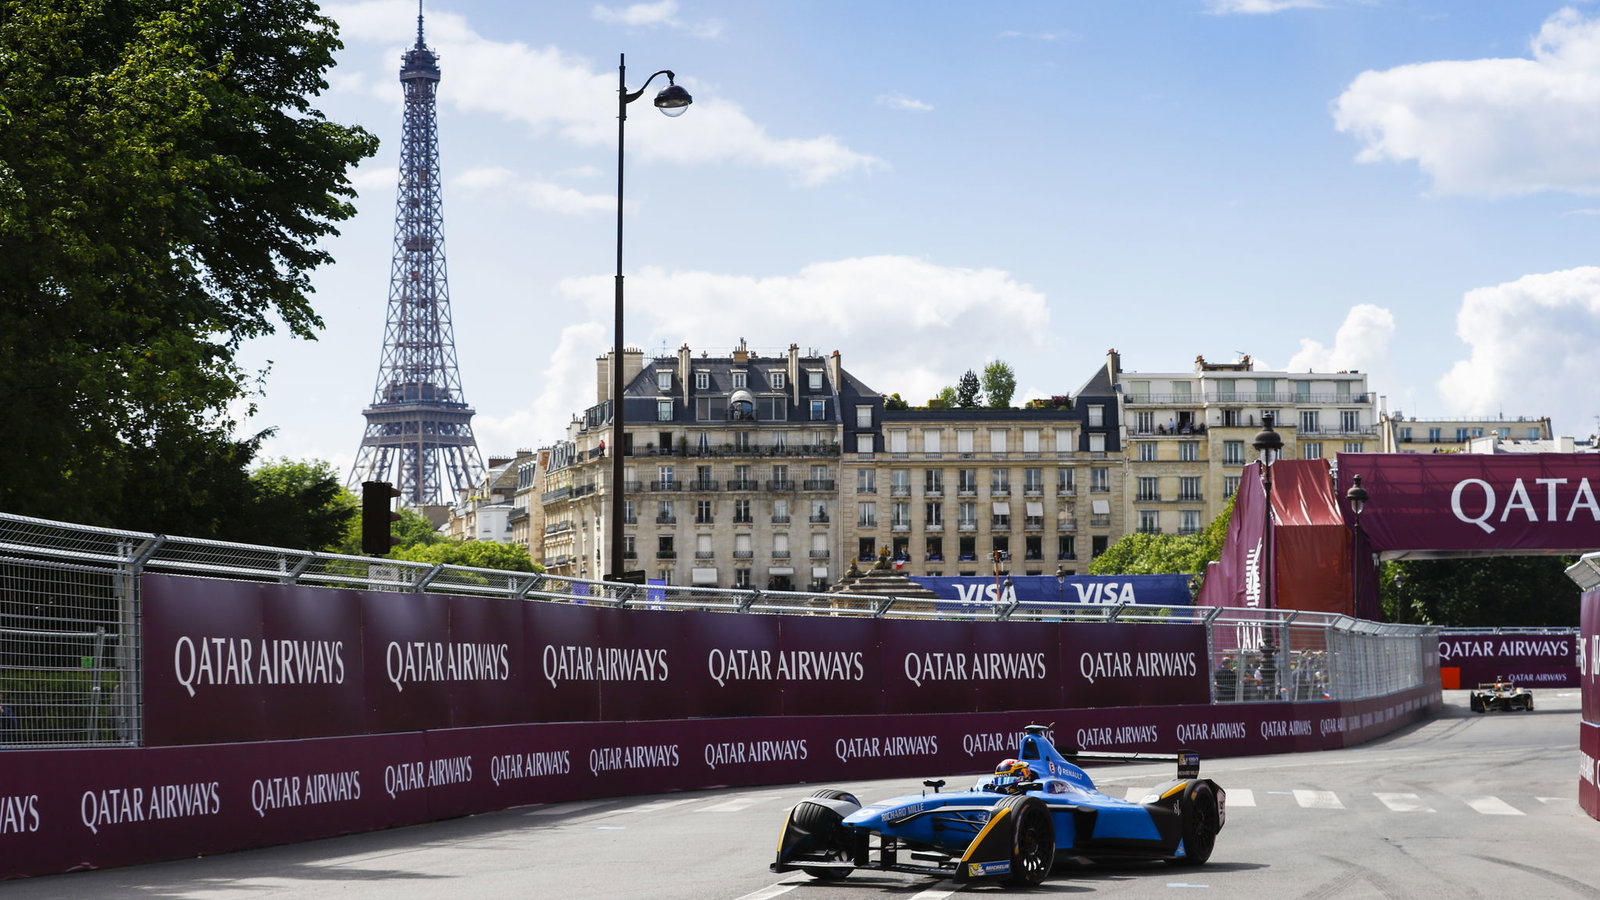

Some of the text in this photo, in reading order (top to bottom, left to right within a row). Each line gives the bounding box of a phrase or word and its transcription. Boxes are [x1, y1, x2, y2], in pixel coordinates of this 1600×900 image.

[952, 583, 1017, 606] VISA
[1071, 583, 1136, 604] VISA
[174, 636, 345, 698] QATAR AIRWAYS
[386, 641, 509, 693] QATAR AIRWAYS
[542, 645, 669, 689] QATAR AIRWAYS
[1437, 641, 1494, 662] QATAR
[1499, 641, 1569, 657] AIRWAYS
[708, 649, 864, 688] QATAR AIRWAYS
[904, 652, 1046, 688] QATAR AIRWAYS
[1079, 652, 1197, 684] QATAR AIRWAYS
[1508, 673, 1567, 682] QATAR AIRWAYS
[963, 732, 1004, 757] QATAR
[1076, 725, 1158, 751] QATAR AIRWAYS
[1176, 722, 1246, 745] QATAR AIRWAYS
[1260, 719, 1312, 741] QATAR AIRWAYS
[589, 745, 679, 777] QATAR AIRWAYS
[704, 739, 808, 770] QATAR AIRWAYS
[835, 735, 938, 763] QATAR AIRWAYS
[384, 756, 473, 799] QATAR AIRWAYS
[490, 750, 570, 787] QATAR AIRWAYS
[1062, 768, 1083, 779] RENAULT
[81, 782, 220, 835] QATAR AIRWAYS
[251, 770, 361, 818] QATAR AIRWAYS
[881, 803, 924, 822] RICHARD MILLE
